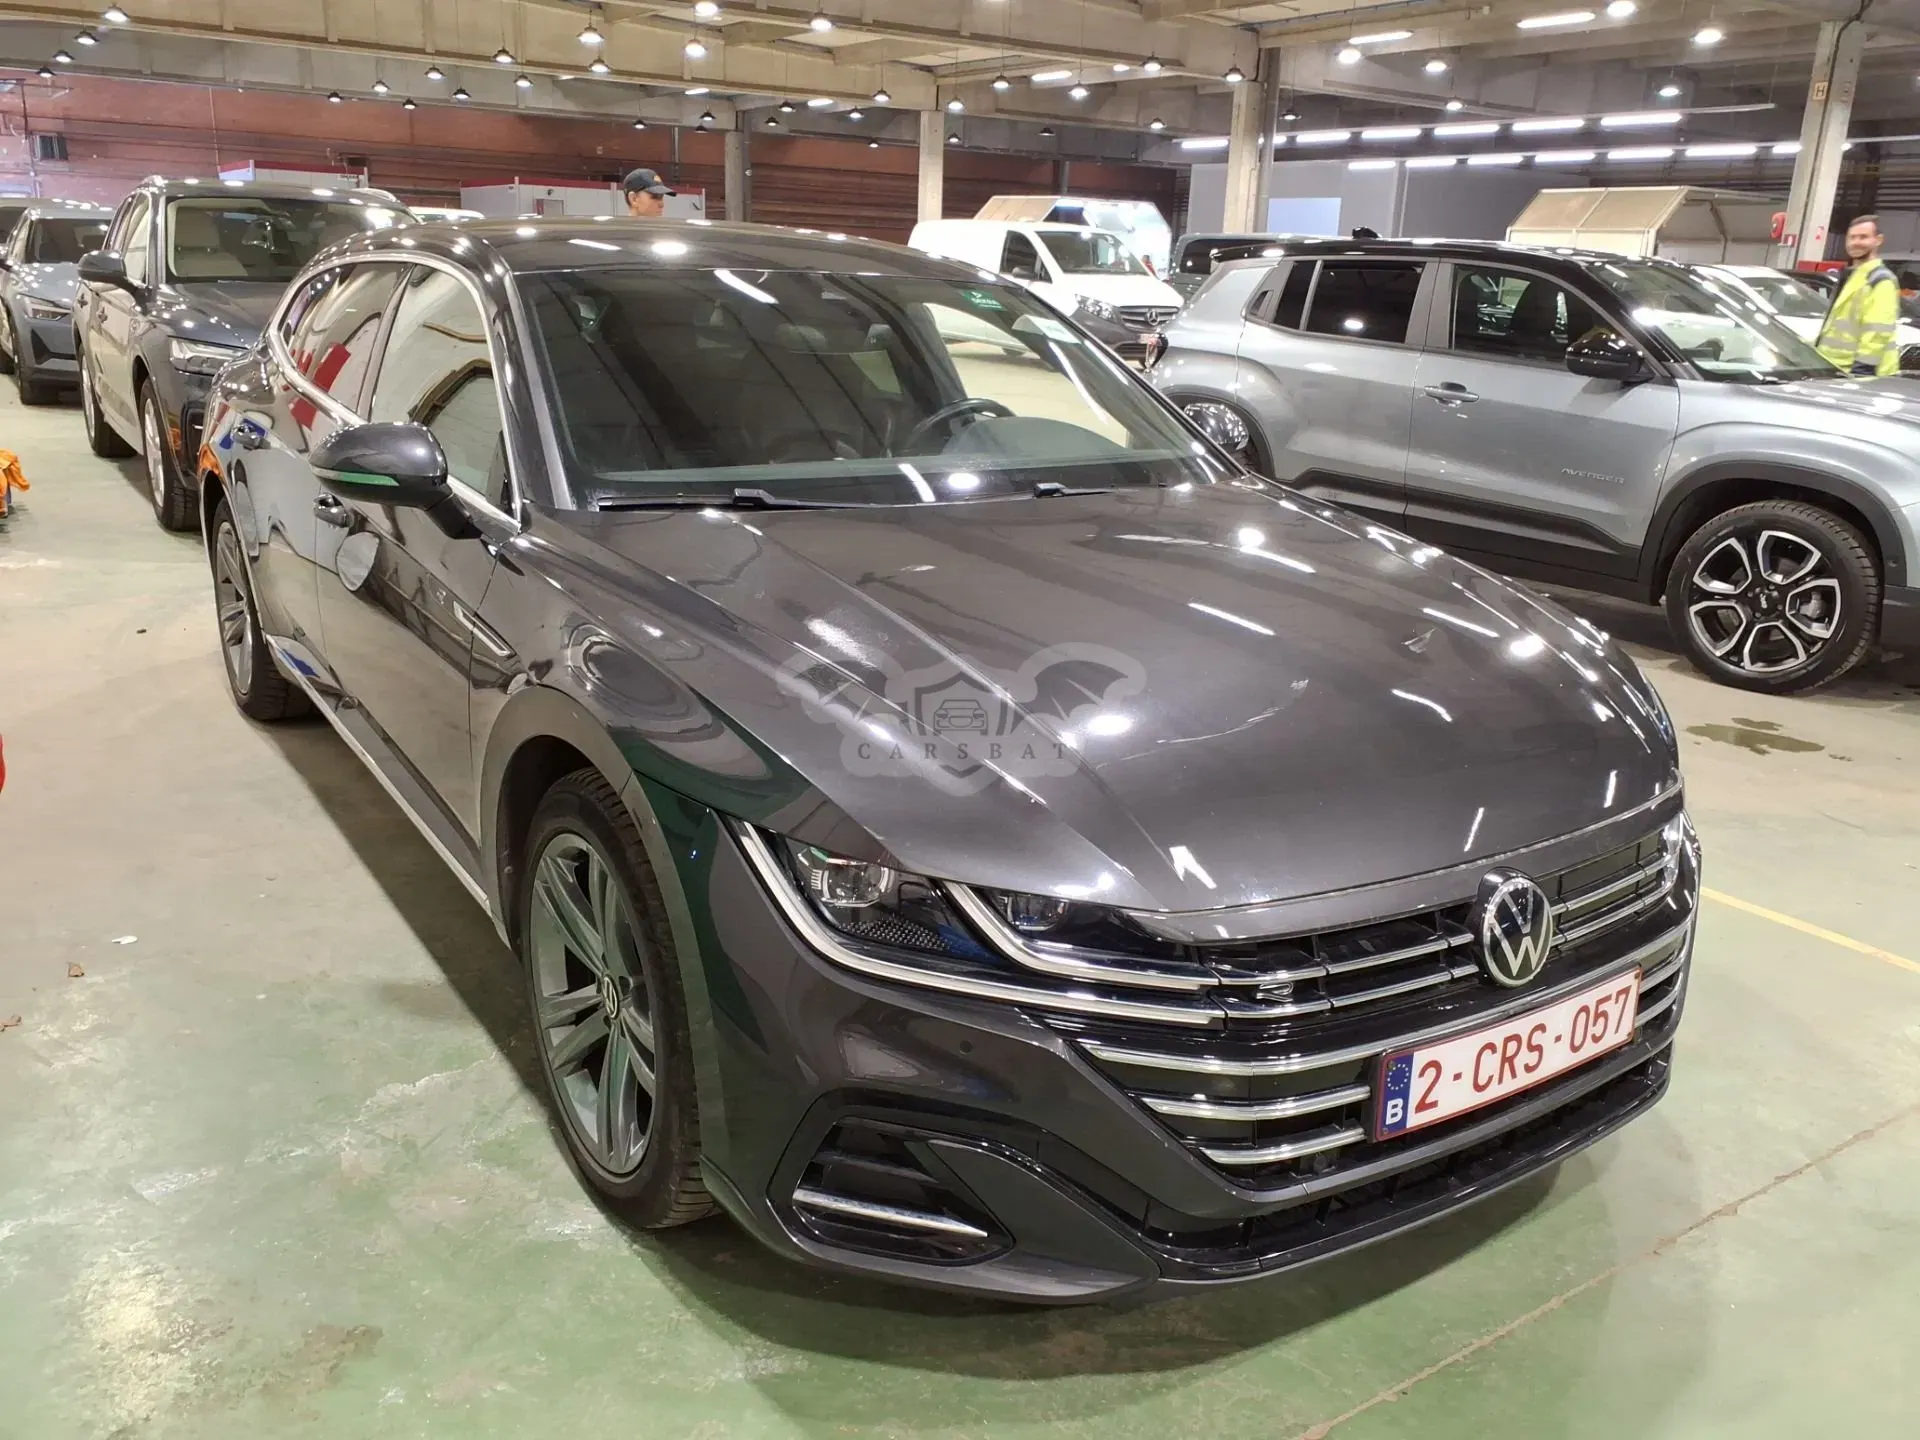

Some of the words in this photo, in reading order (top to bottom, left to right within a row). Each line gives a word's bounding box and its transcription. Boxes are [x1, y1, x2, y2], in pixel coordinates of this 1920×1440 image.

[1561, 467, 1625, 484] AVENGER
[1414, 984, 1632, 1114] 2-CRS-057
[1385, 1097, 1403, 1126] B
